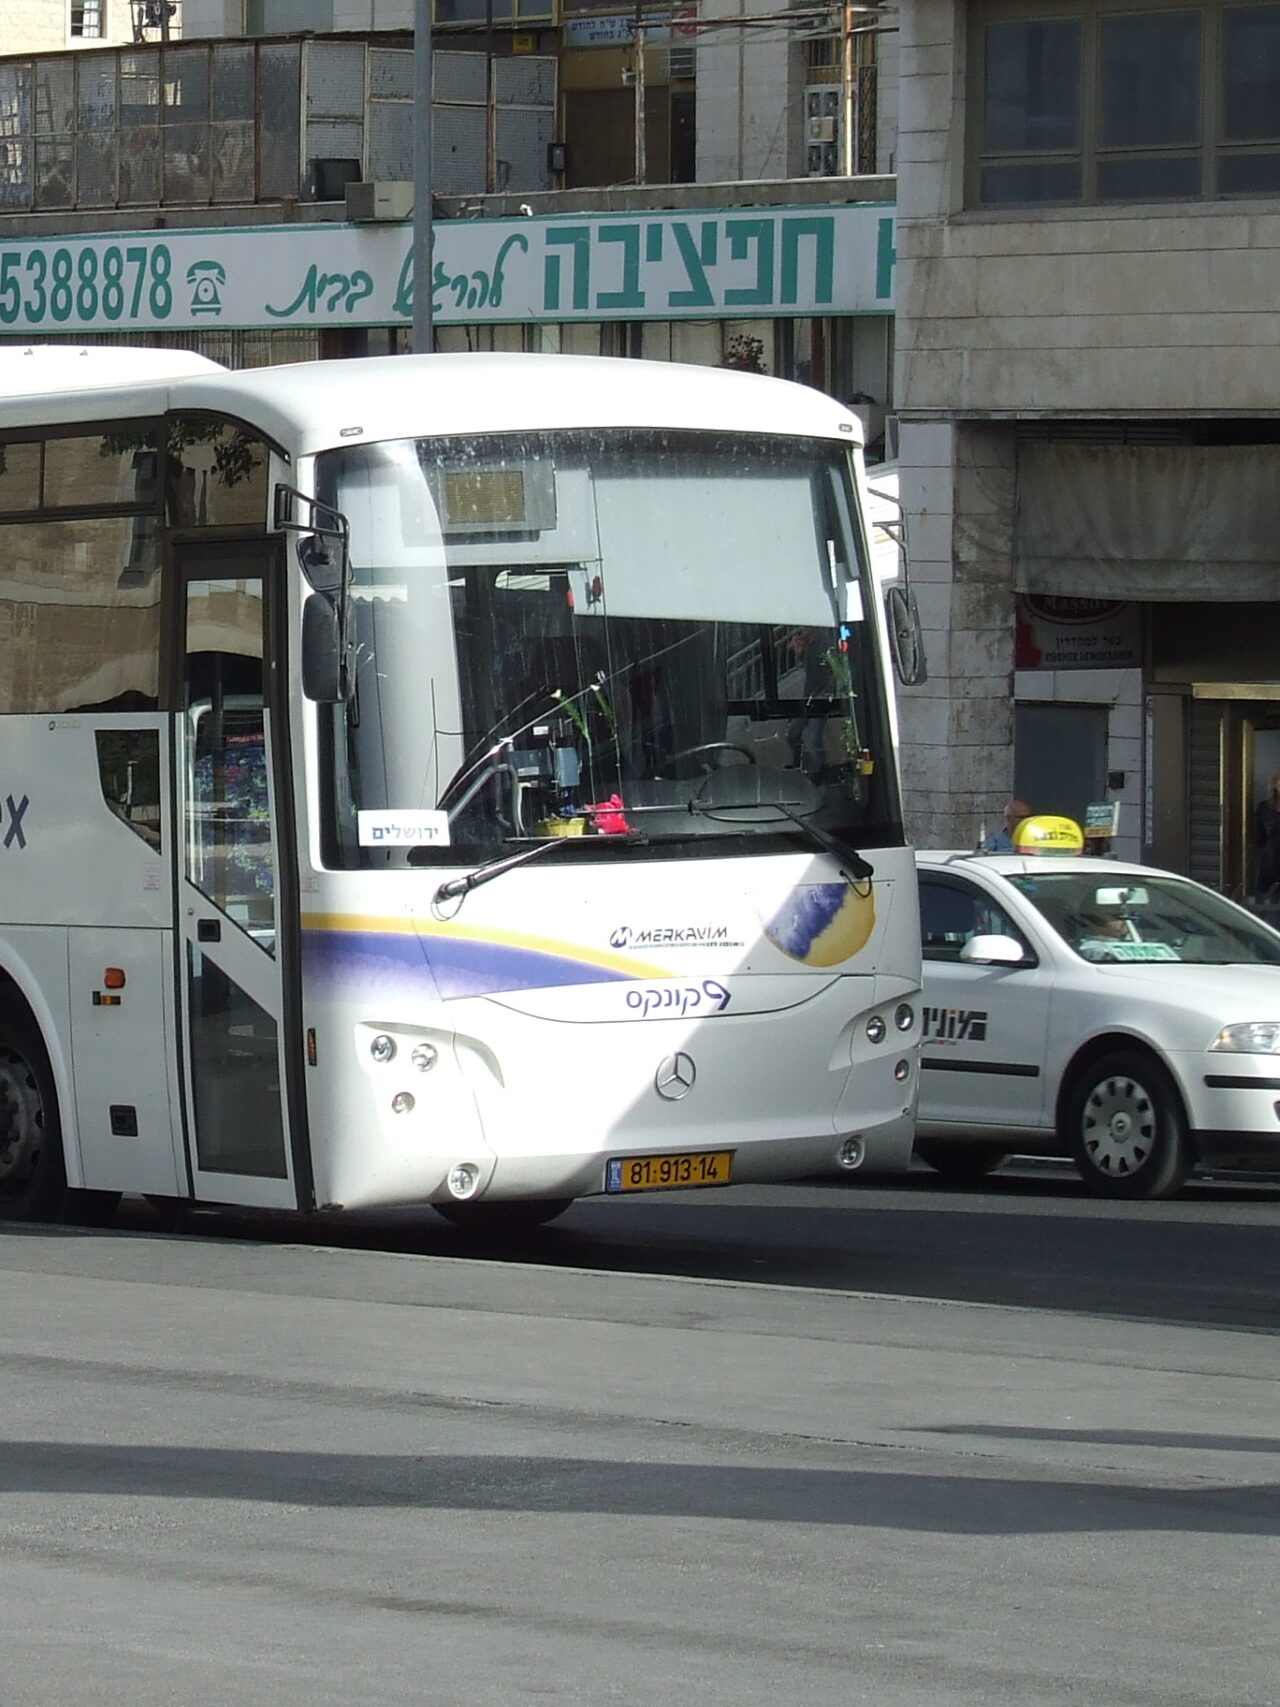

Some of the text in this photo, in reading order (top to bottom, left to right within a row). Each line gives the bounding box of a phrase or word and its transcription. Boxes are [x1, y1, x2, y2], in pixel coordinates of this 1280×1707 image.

[543, 216, 836, 311] חפציבה
[265, 263, 374, 317] בבית
[371, 823, 438, 840] ירושלים
[635, 922, 728, 942] MERKAVIM
[626, 988, 701, 1017] קונקס
